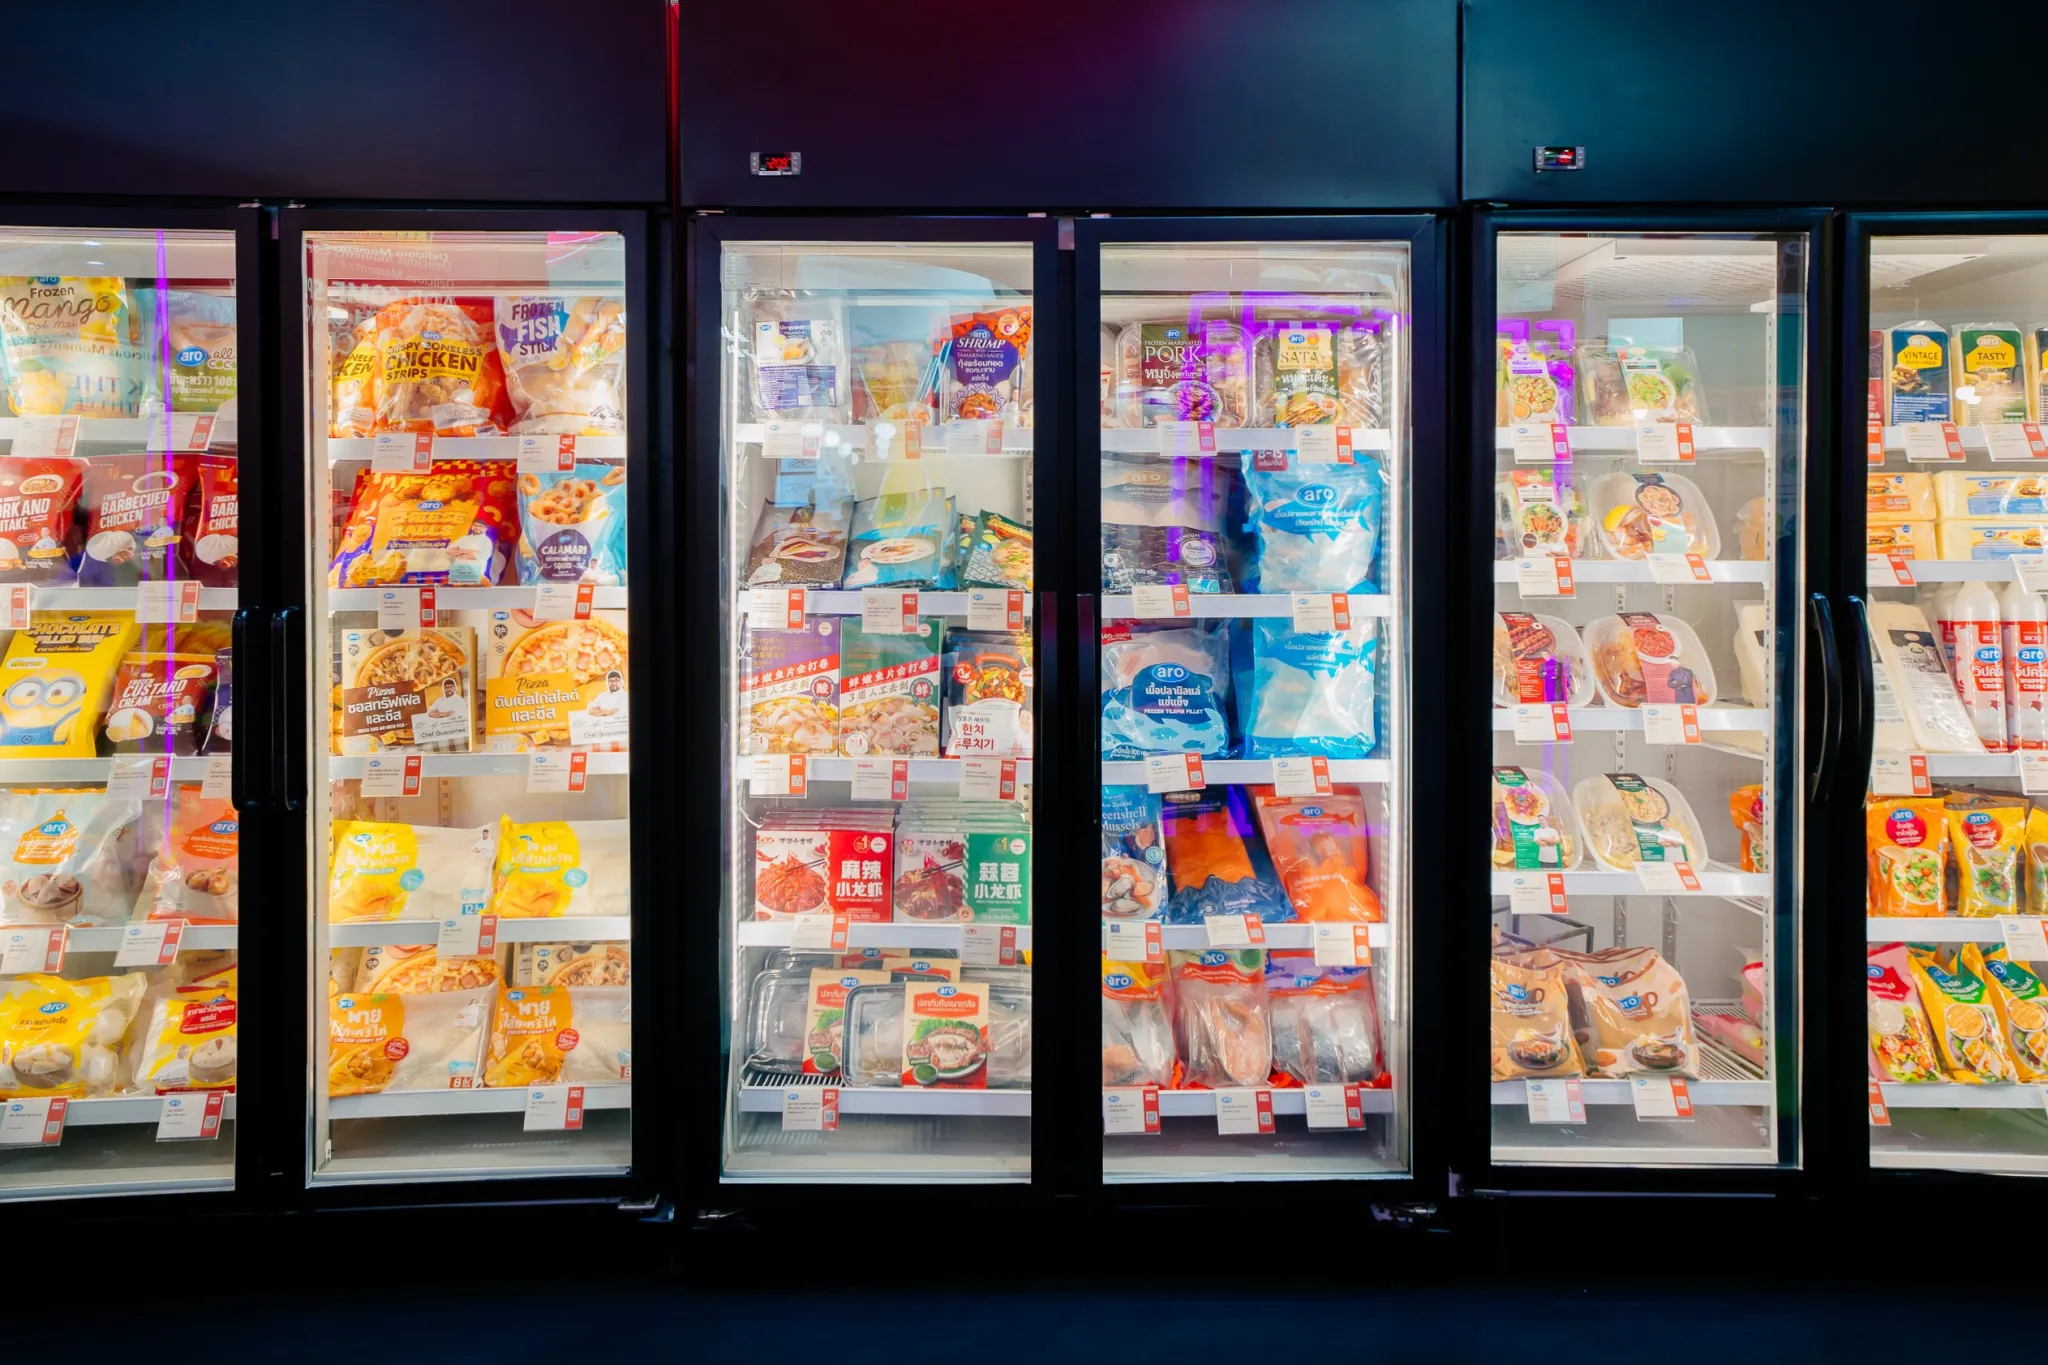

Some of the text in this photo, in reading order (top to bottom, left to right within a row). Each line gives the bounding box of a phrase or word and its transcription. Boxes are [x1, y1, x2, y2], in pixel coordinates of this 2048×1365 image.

[30, 287, 75, 298] Frozen
[3, 296, 110, 324] Mango
[511, 301, 565, 321] FROZEN
[517, 314, 562, 342] FISH
[423, 331, 440, 339] aro
[972, 331, 988, 339] aro
[387, 341, 483, 356] CRISPY BONELESS
[956, 337, 1006, 349] SHRIMP
[1910, 338, 1928, 346] aro
[1980, 338, 1999, 346] aro
[181, 351, 203, 362] aro
[213, 347, 236, 360] all
[1145, 345, 1203, 363] PORK
[1903, 351, 1938, 360] VINTAGE
[1977, 352, 2007, 361] TASTY
[385, 351, 478, 372] CHICKEN
[386, 368, 428, 381] STRIPS
[1131, 473, 1161, 481] aro
[1304, 488, 1335, 501] aro
[21, 498, 51, 516] AND
[101, 490, 170, 516] BARBECUED
[100, 509, 144, 529] CHICKEN
[392, 511, 468, 524] CHEESE
[391, 524, 454, 537] BALLS
[541, 544, 588, 555] CALAMARI
[494, 612, 508, 620] aro
[1980, 650, 2000, 659] aro
[2021, 650, 2044, 660] aro
[1157, 666, 1185, 678] aro
[122, 679, 188, 699] CUSTARD
[516, 677, 550, 691] Pizza
[815, 682, 829, 695] 酸
[1145, 682, 1201, 696] เนื้อปลานิลแล่
[367, 686, 397, 699] Pizza
[119, 696, 153, 709] CREAM
[962, 723, 984, 736] 한치
[1303, 807, 1322, 815] aro
[1894, 811, 1912, 819] aro
[1970, 815, 1988, 823] aro
[44, 823, 66, 833] aro
[214, 823, 236, 832] aro
[841, 860, 882, 880] 麻辣
[979, 862, 1020, 882] 蒜蓉
[836, 882, 883, 898] 小龙虾
[974, 883, 1022, 900] 小龙虾
[1204, 952, 1226, 963] aro
[1108, 975, 1130, 986] aro
[1511, 987, 1524, 997] aro
[42, 1003, 67, 1012] aro
[518, 1000, 551, 1017] พาย
[348, 1007, 383, 1024] พาย
[452, 1077, 461, 1088] 8
